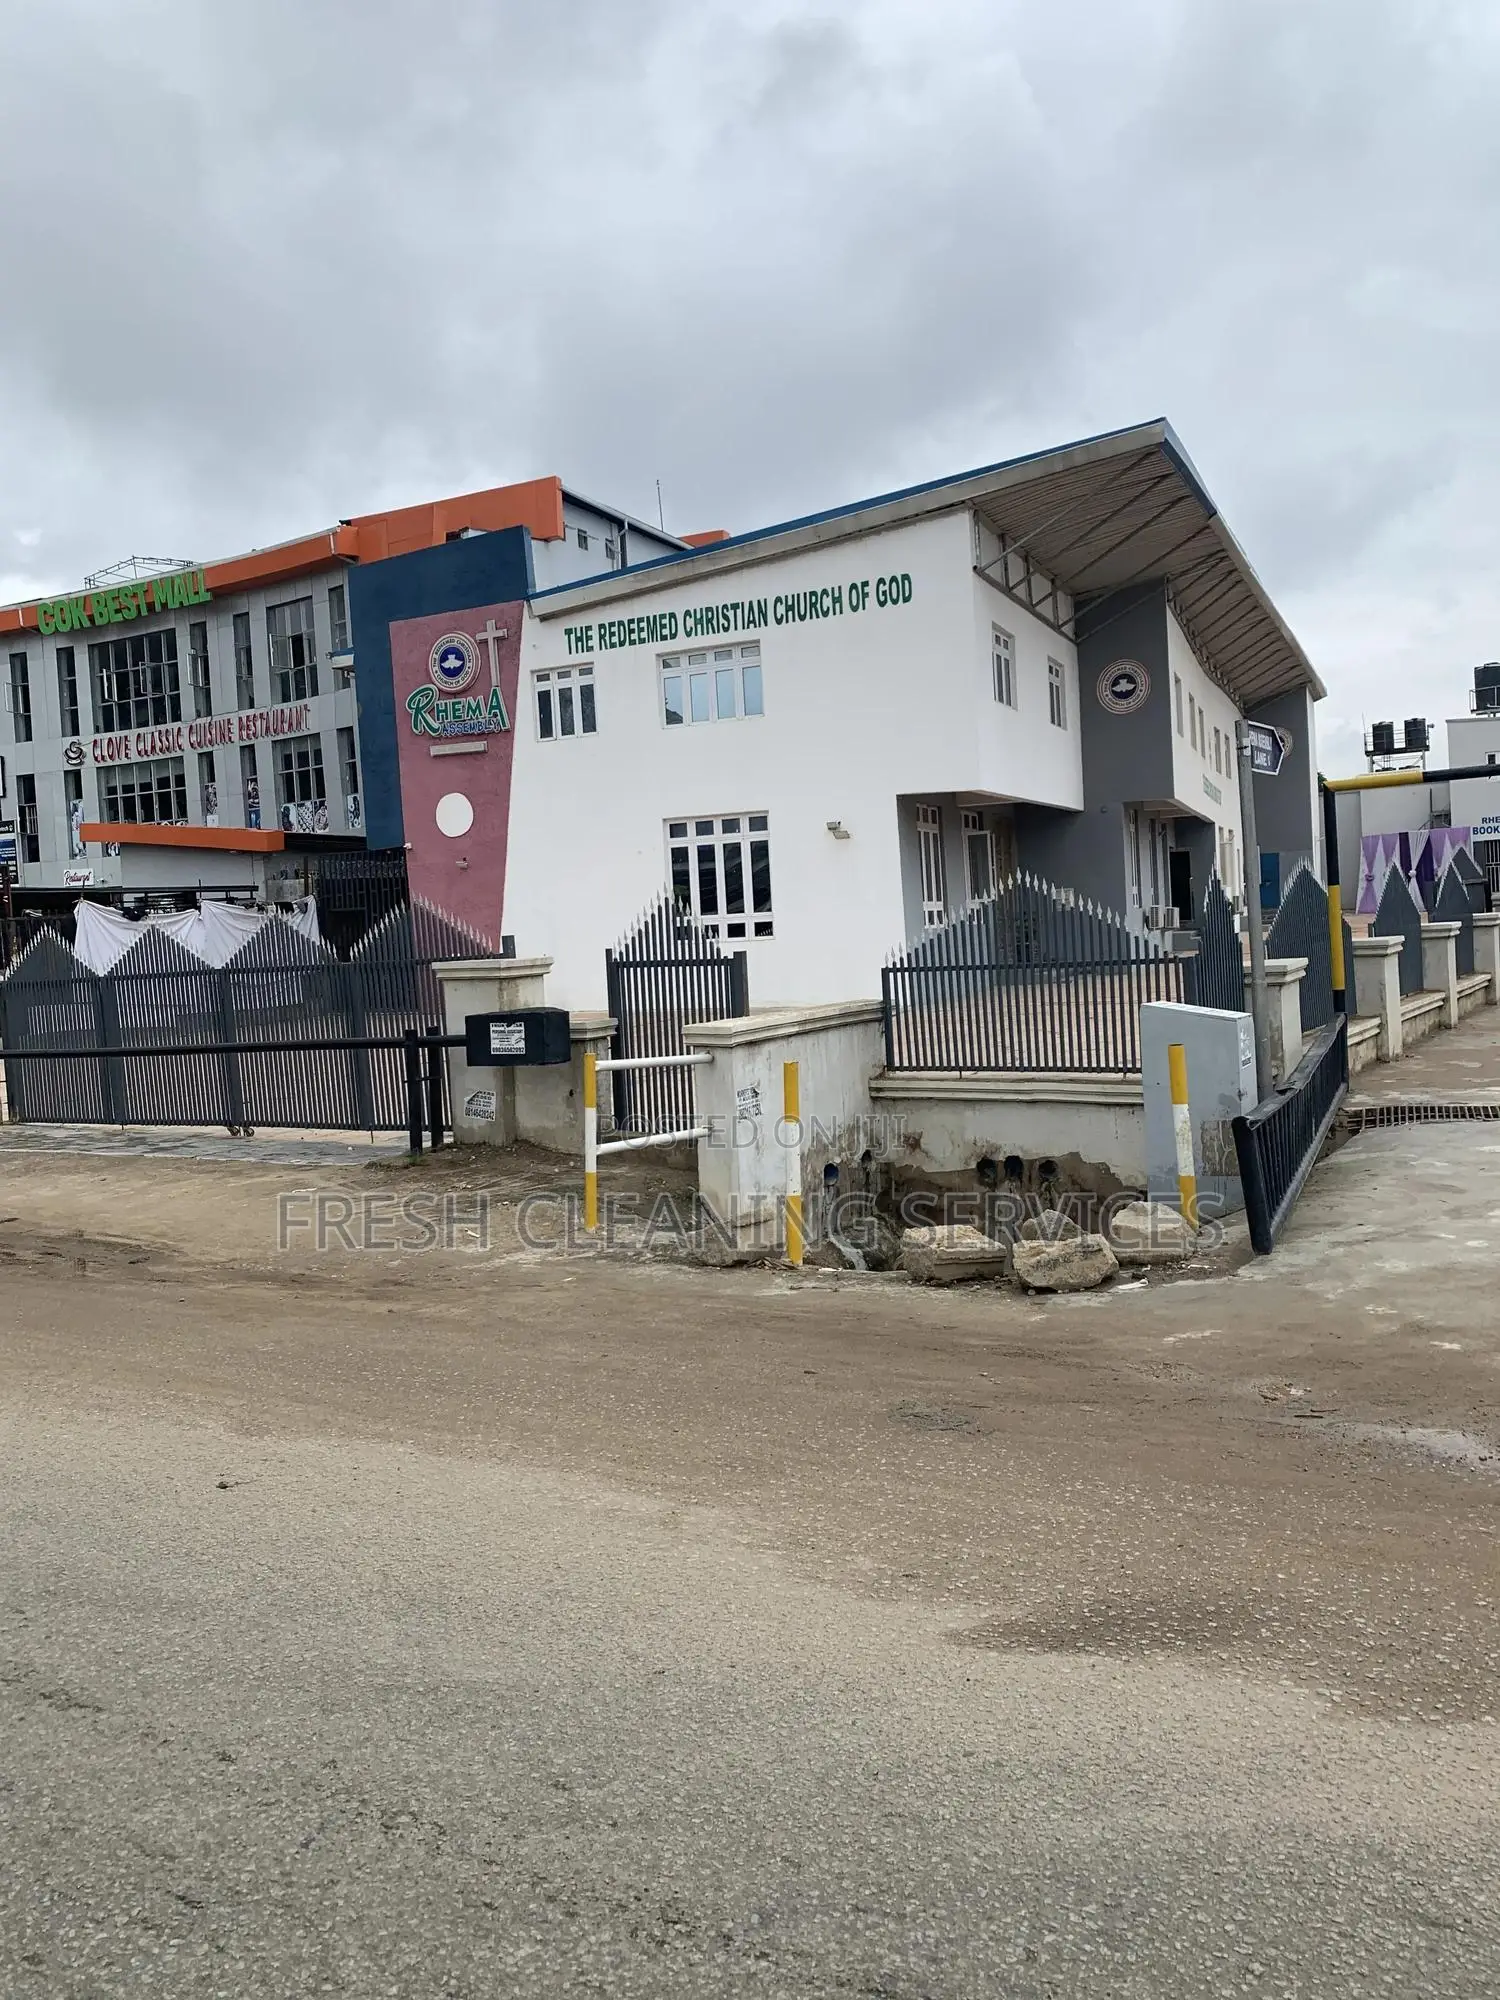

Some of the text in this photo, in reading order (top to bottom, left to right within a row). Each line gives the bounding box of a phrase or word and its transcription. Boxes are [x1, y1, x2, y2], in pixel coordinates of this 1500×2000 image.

[92, 582, 148, 626] BEST
[152, 568, 212, 613] MALL
[564, 573, 913, 655] THE REDEEMED CHRISTIAN CHURCH OF GOD
[93, 703, 310, 763] CLOVE CLASSIC CUISINE RESTAURANT
[406, 685, 509, 735] RHEMA
[442, 718, 501, 736] ASSEMBLY
